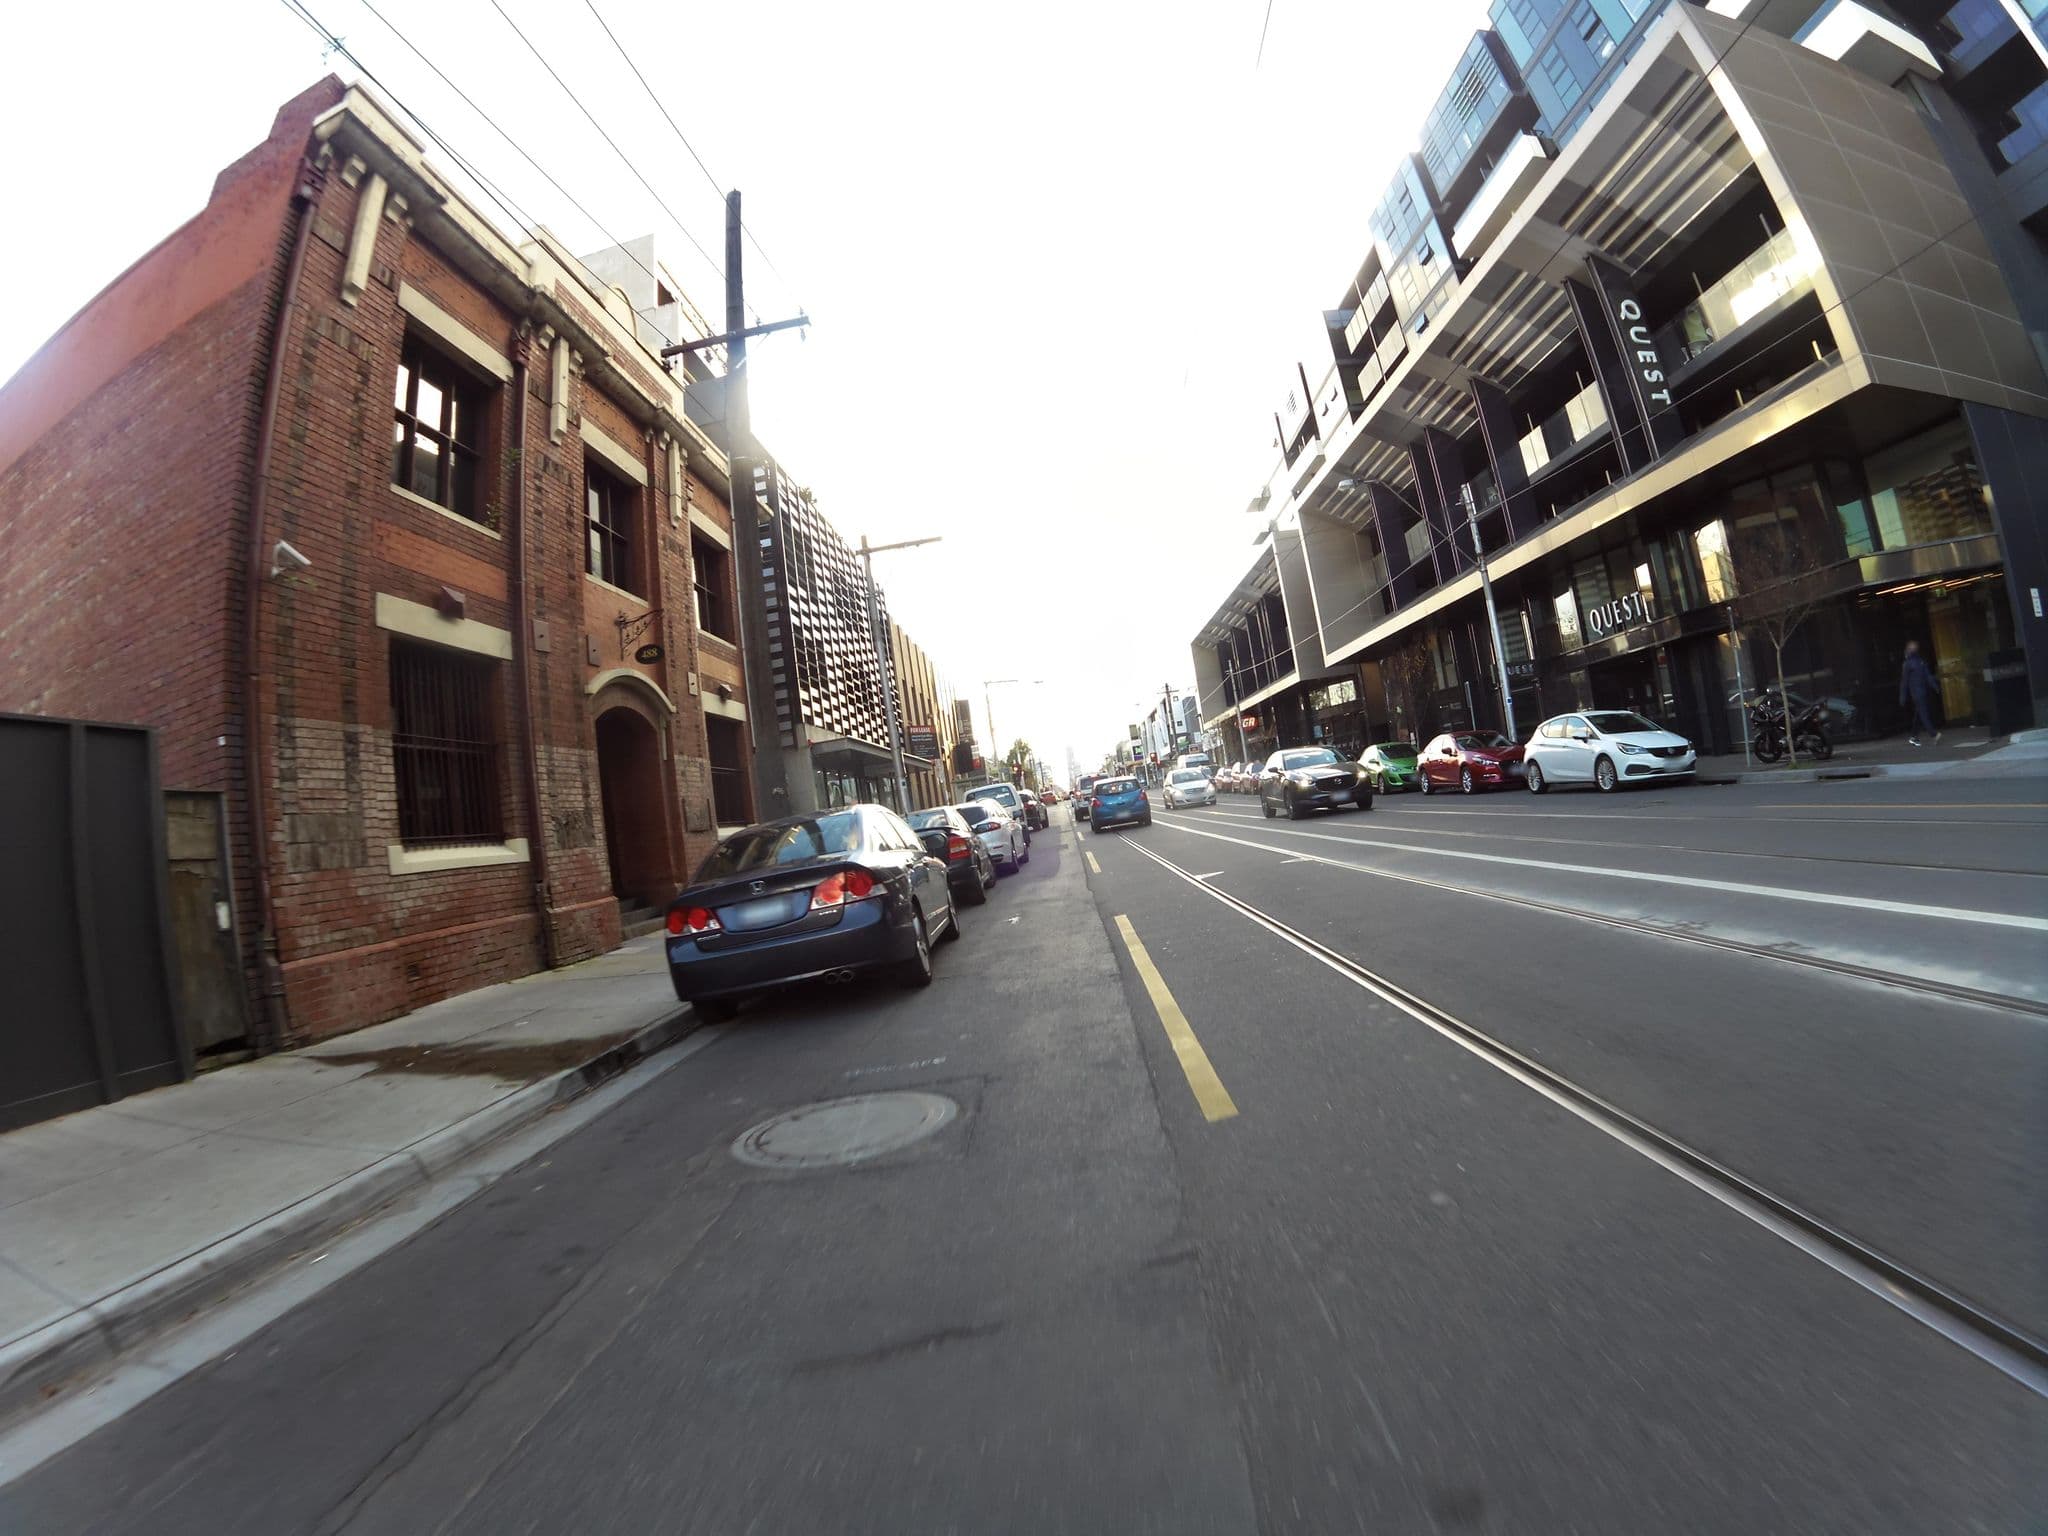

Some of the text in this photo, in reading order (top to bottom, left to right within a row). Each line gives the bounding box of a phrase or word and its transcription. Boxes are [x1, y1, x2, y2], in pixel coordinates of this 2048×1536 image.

[1621, 300, 1671, 405] QUEST
[1590, 591, 1641, 636] QUEST
[1506, 664, 1534, 675] UEST
